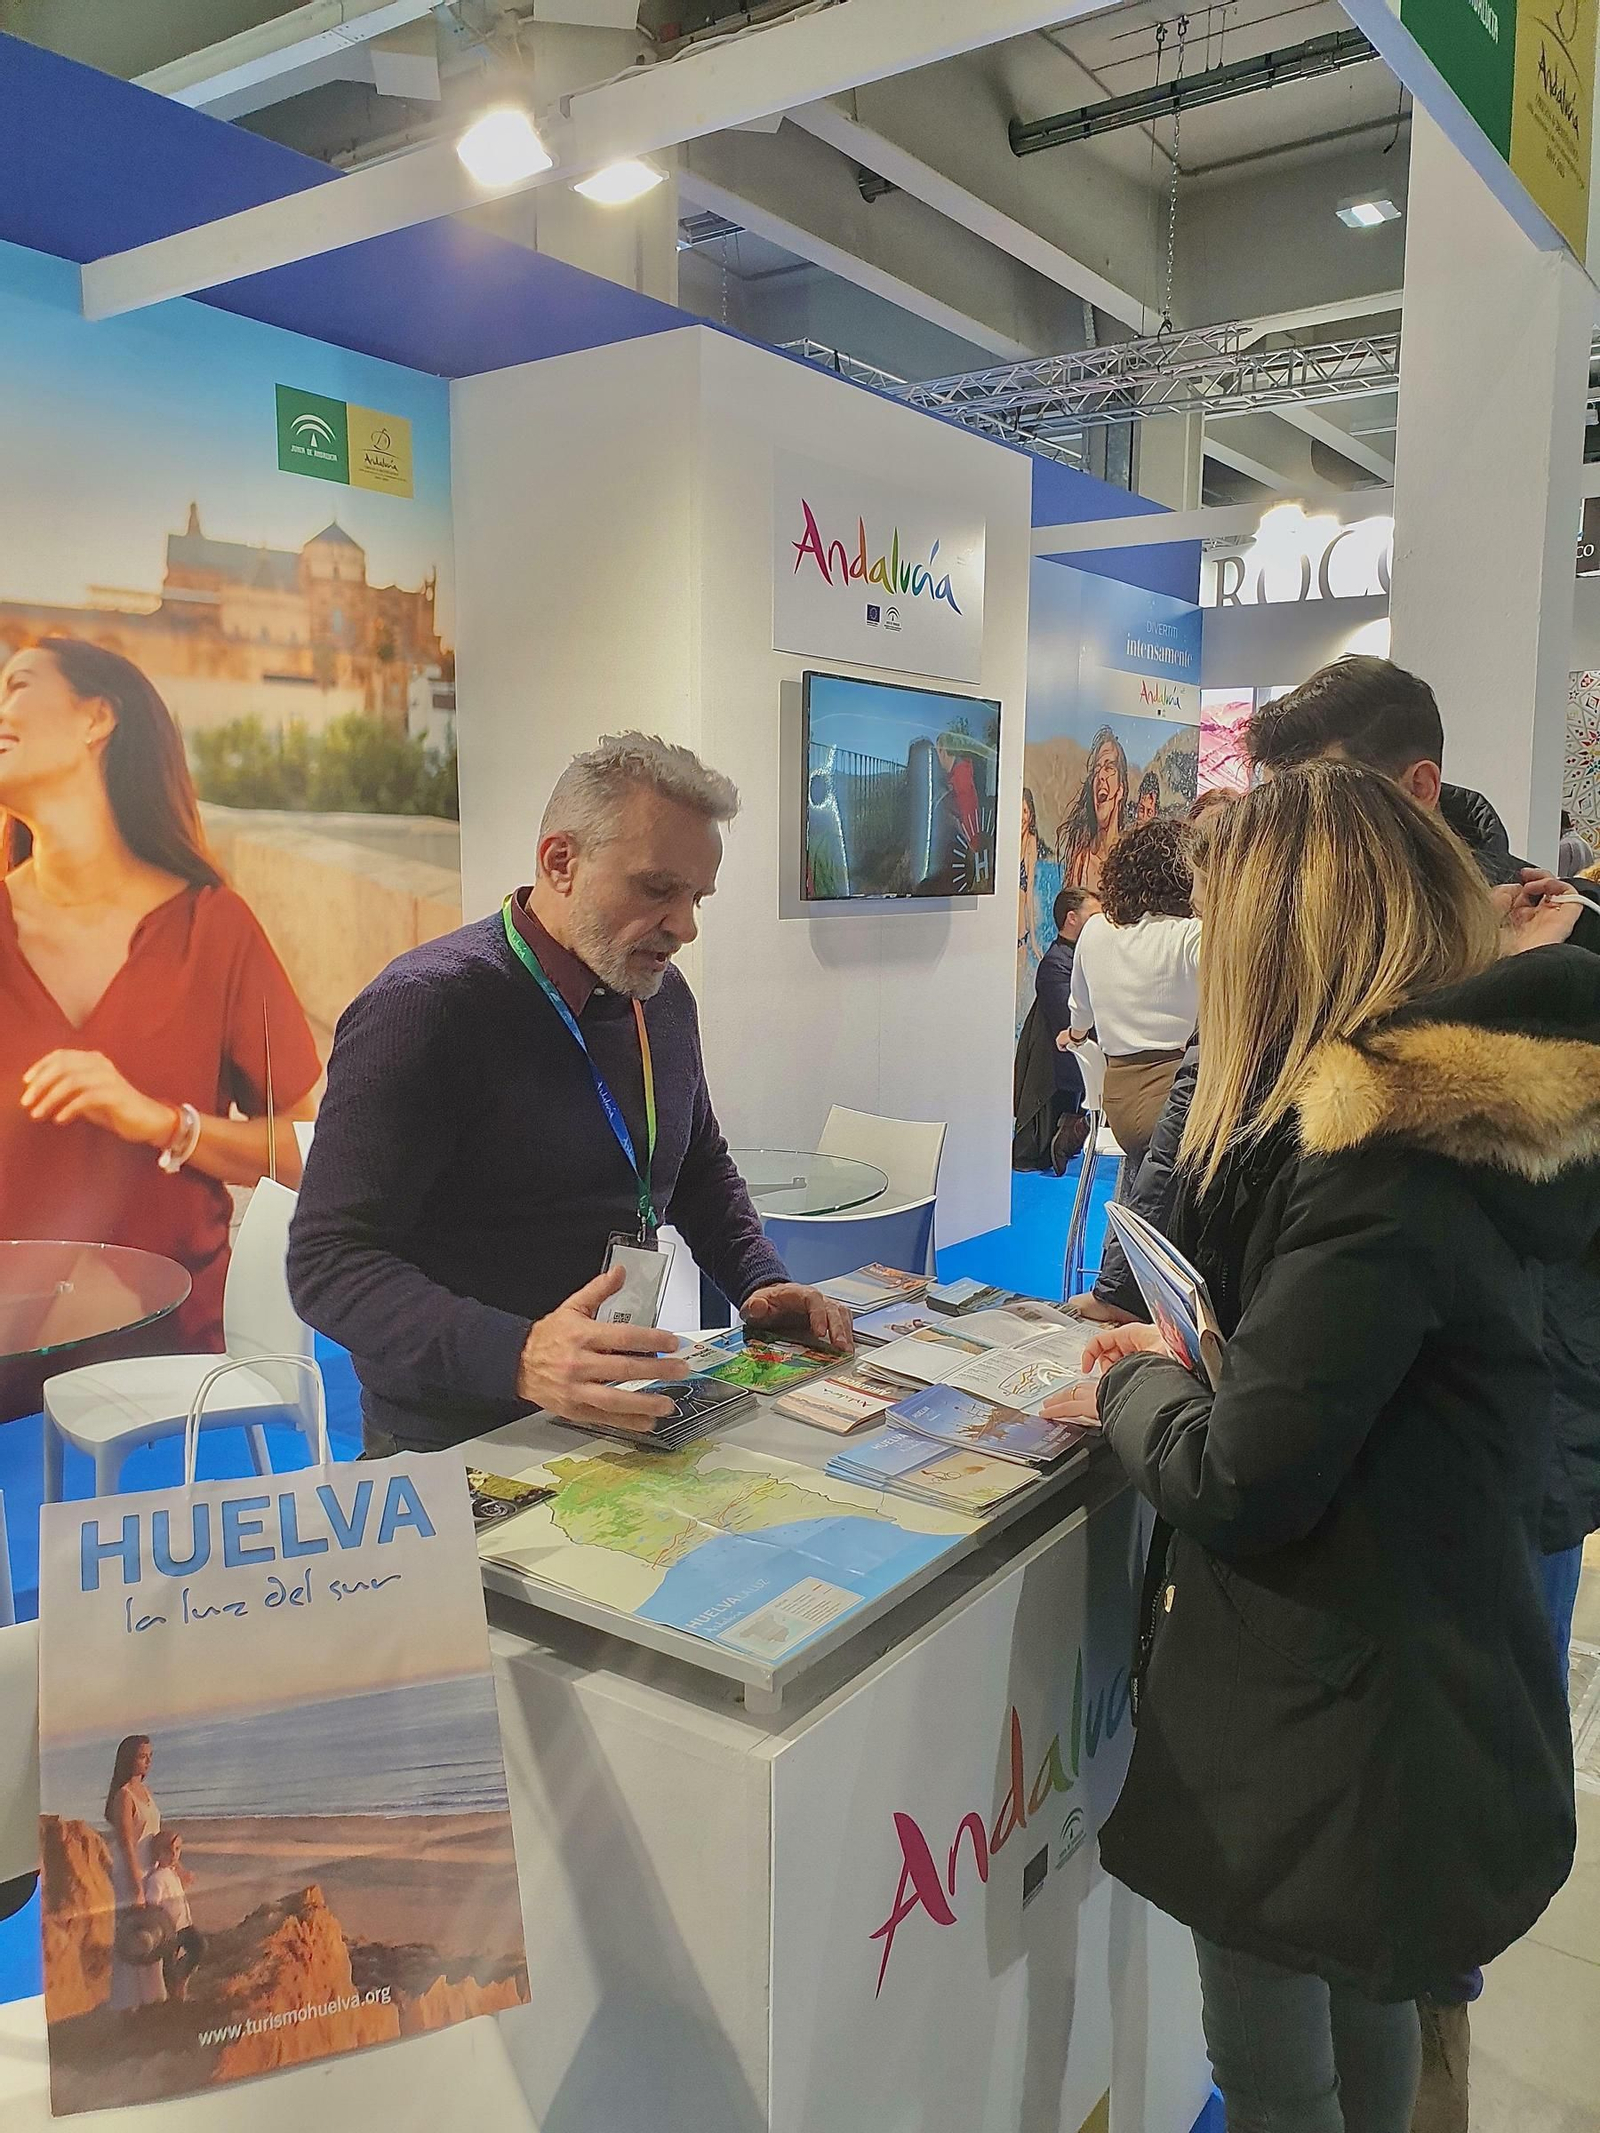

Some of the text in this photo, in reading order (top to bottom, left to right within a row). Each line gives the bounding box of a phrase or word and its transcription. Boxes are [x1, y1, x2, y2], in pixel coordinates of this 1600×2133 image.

[791, 497, 964, 617] Andalucía
[1126, 632, 1194, 669] intensamente
[1146, 620, 1179, 640] DIVERTITI
[870, 1433, 909, 1451] HUELVA
[80, 1474, 438, 1592] HUELVA
[125, 1567, 402, 1634] la luz del sur
[198, 1985, 392, 2047] www.turismohuelva.org
